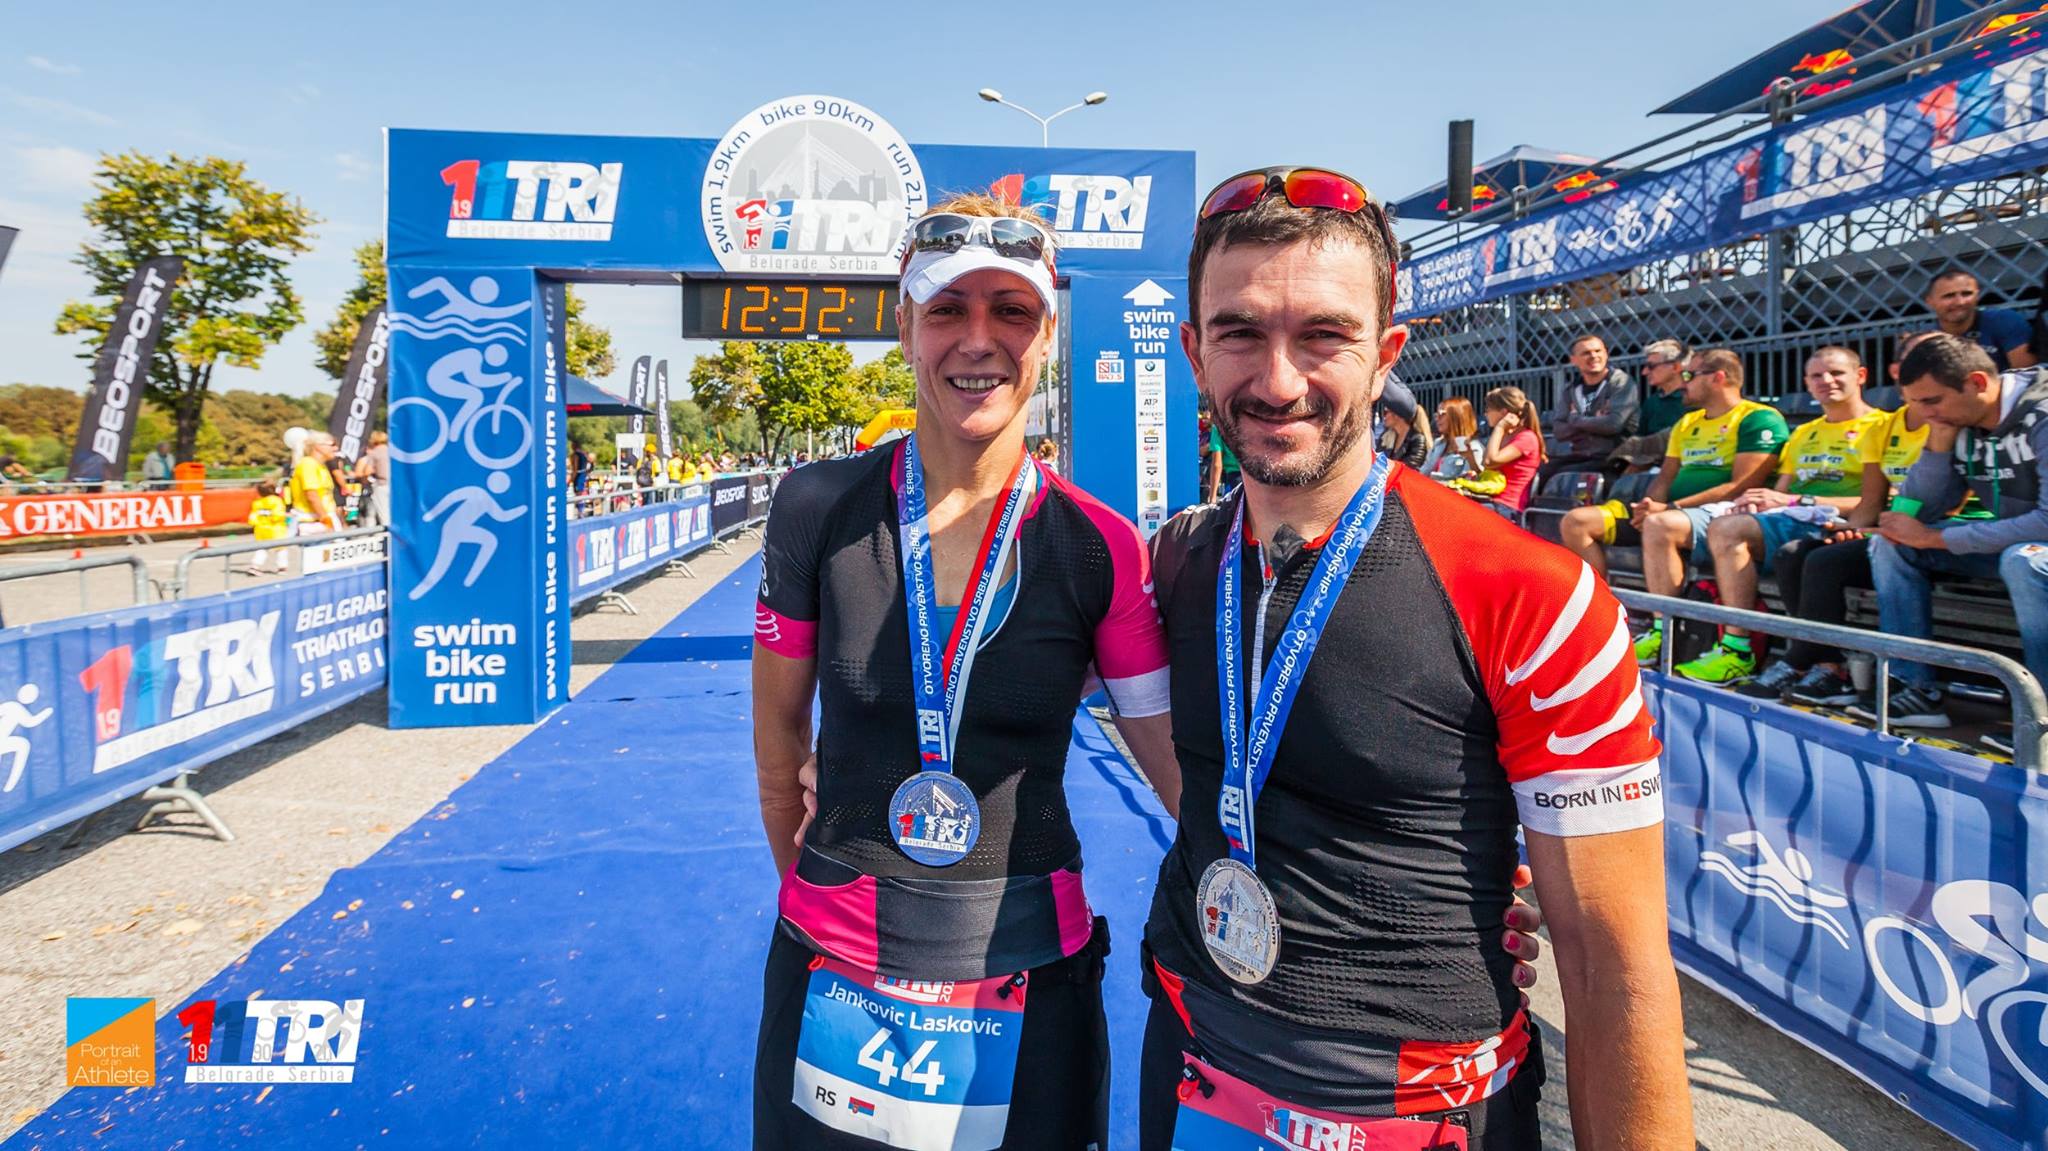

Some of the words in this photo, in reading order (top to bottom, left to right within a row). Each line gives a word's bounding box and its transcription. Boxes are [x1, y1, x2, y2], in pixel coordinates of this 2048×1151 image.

[760, 103, 806, 126] bike
[814, 100, 875, 132] 90km
[708, 130, 751, 191] 1,9km
[887, 142, 912, 177] run
[459, 220, 534, 239] Belgrade
[549, 222, 603, 240] Serbia
[708, 196, 734, 254] swim
[1087, 233, 1136, 248] Serbia
[749, 255, 818, 272] Belgrade
[829, 256, 879, 271] Serbia
[547, 287, 555, 334] run
[1123, 308, 1175, 323] swim
[1129, 324, 1170, 339] bike
[92, 267, 167, 464] BEOSPORT
[1134, 342, 1165, 354] run
[545, 341, 557, 402] bike
[545, 410, 557, 488] swim
[906, 457, 915, 495] SERBIAN
[1366, 473, 1387, 503] OPEN
[13, 495, 206, 535] GENERALI
[546, 496, 556, 544] run
[909, 526, 921, 560] SRBIJE
[1320, 503, 1372, 594] CHAMPIONSHIP
[545, 551, 557, 614] bike
[912, 560, 928, 627] PRVENSTVO
[951, 606, 979, 674] PRVENSTVO
[973, 569, 991, 606] SRBIJE
[996, 500, 1016, 539] SERBIAN
[1012, 474, 1026, 500] OPEN
[1224, 566, 1233, 606] SRBIJE
[414, 618, 517, 647] swim
[1225, 607, 1236, 687] PRVENSTVO
[425, 648, 507, 678] bike
[545, 620, 557, 700] swim
[921, 627, 934, 695] OTVORENO
[1272, 629, 1307, 704] OTVORENO
[434, 681, 497, 705] run
[1227, 689, 1239, 768] OTVORENO
[1534, 789, 1597, 809] BORN
[1602, 785, 1622, 803] IN
[1641, 775, 1662, 797] SW
[825, 981, 905, 1027] Jankovic
[909, 1010, 1002, 1037] Laskovic
[858, 1027, 945, 1096] 44
[816, 1085, 837, 1107] RS
